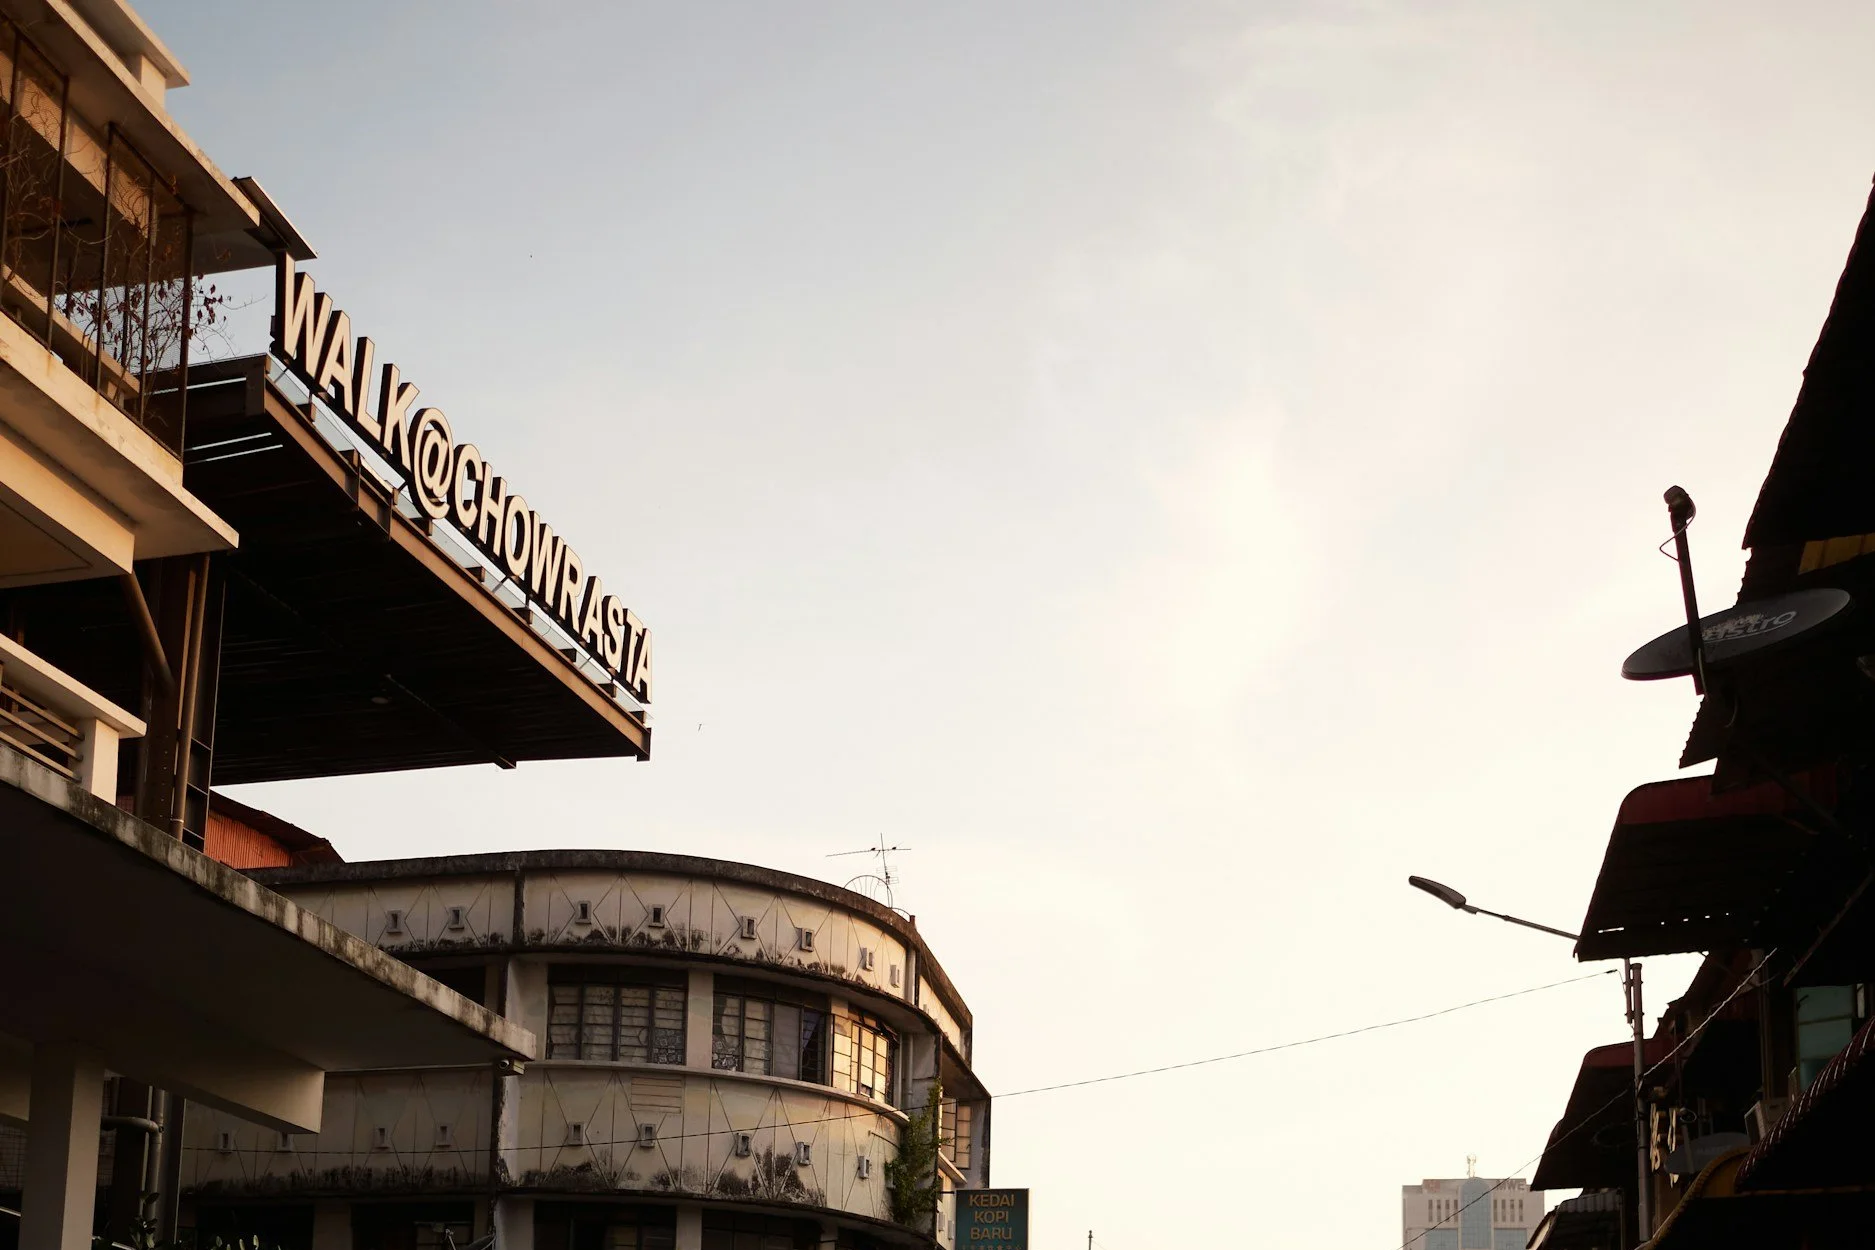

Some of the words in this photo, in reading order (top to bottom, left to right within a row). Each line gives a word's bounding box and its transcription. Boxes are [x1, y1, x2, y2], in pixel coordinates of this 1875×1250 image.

[280, 252, 651, 703] WALK@CHOWRASTA
[969, 1194, 1014, 1207] KEDAI
[974, 1210, 1009, 1224] KOPI
[970, 1227, 1012, 1240] BARU
